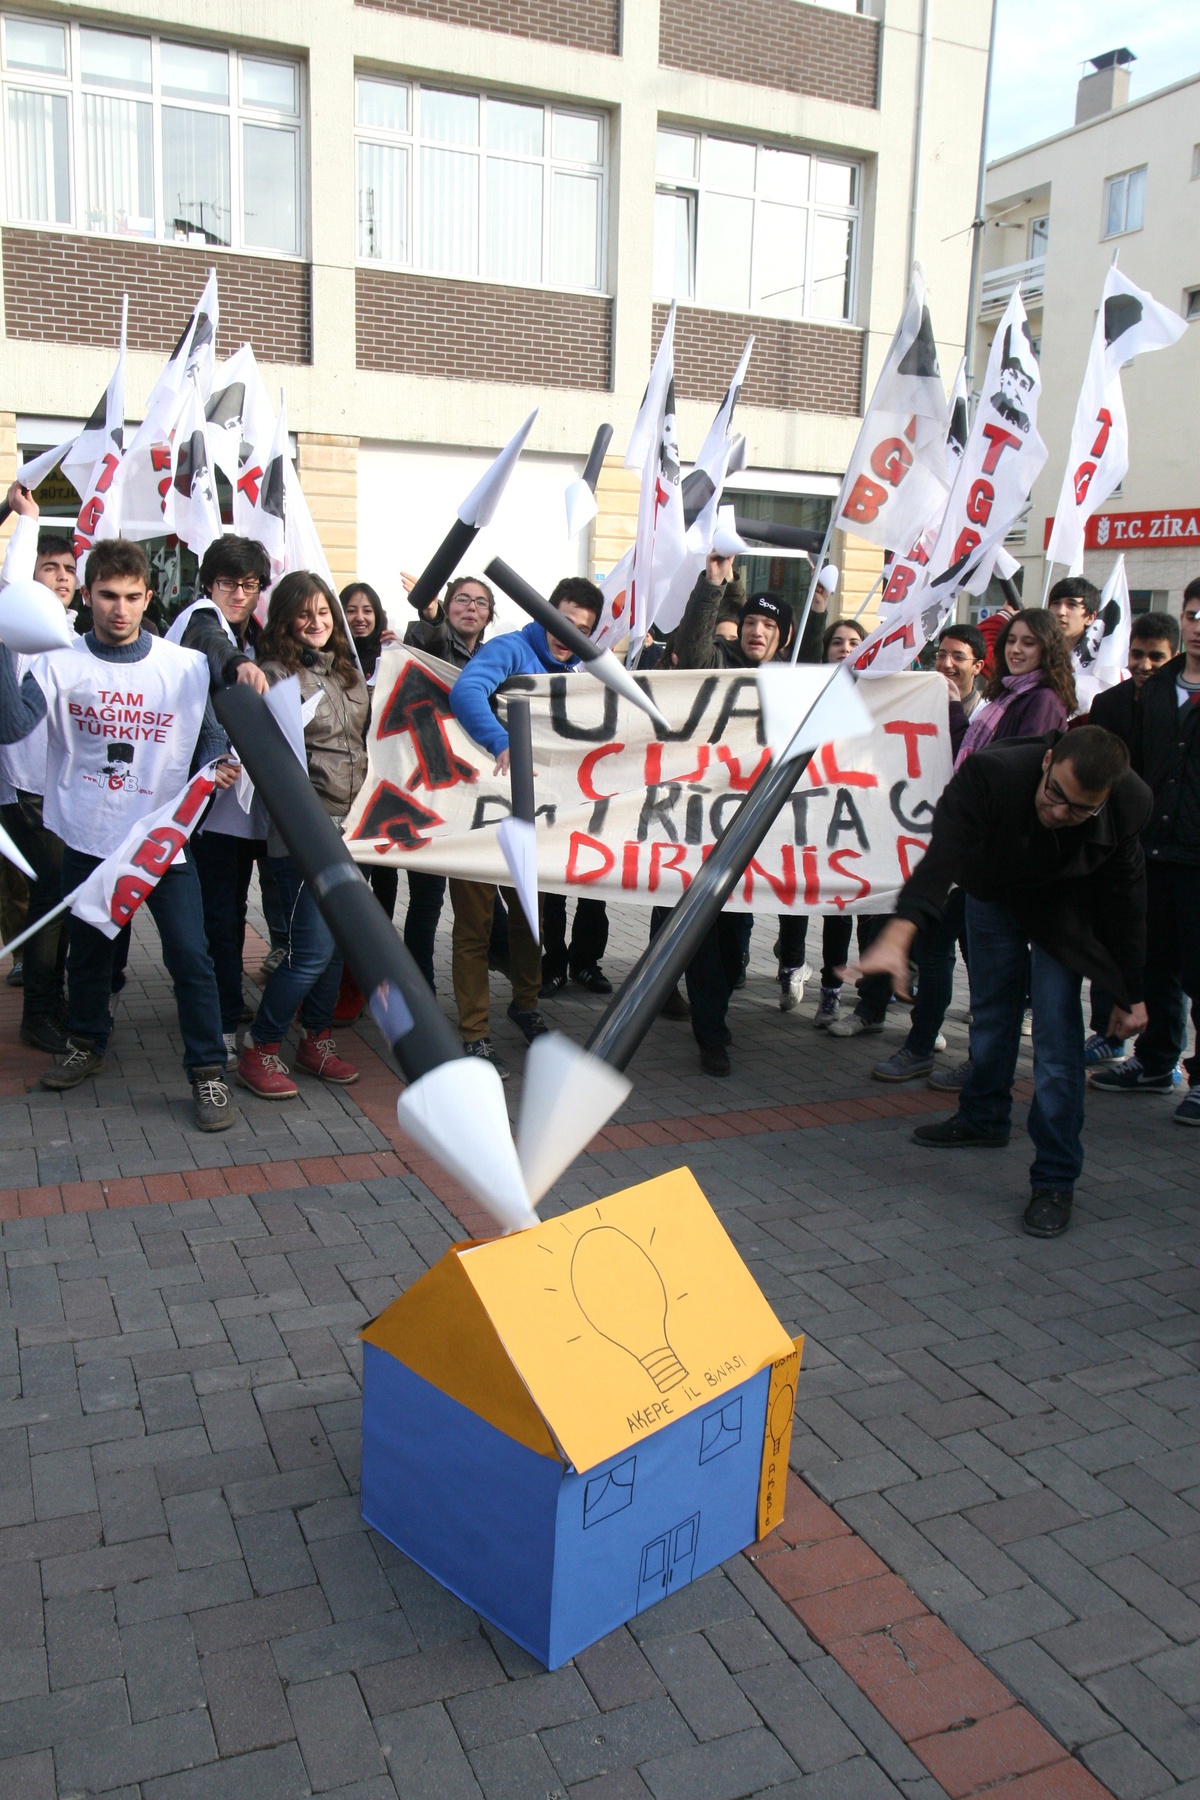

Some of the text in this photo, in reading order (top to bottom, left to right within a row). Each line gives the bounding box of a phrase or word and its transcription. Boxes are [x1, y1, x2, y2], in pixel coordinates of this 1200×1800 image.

[1114, 519, 1145, 539] T.C.
[98, 690, 143, 707] TAM
[68, 702, 174, 728] BAĞIMSIZ
[74, 718, 167, 744] TÜRKİYE
[626, 1353, 748, 1435] AKEPE İL BİNASI
